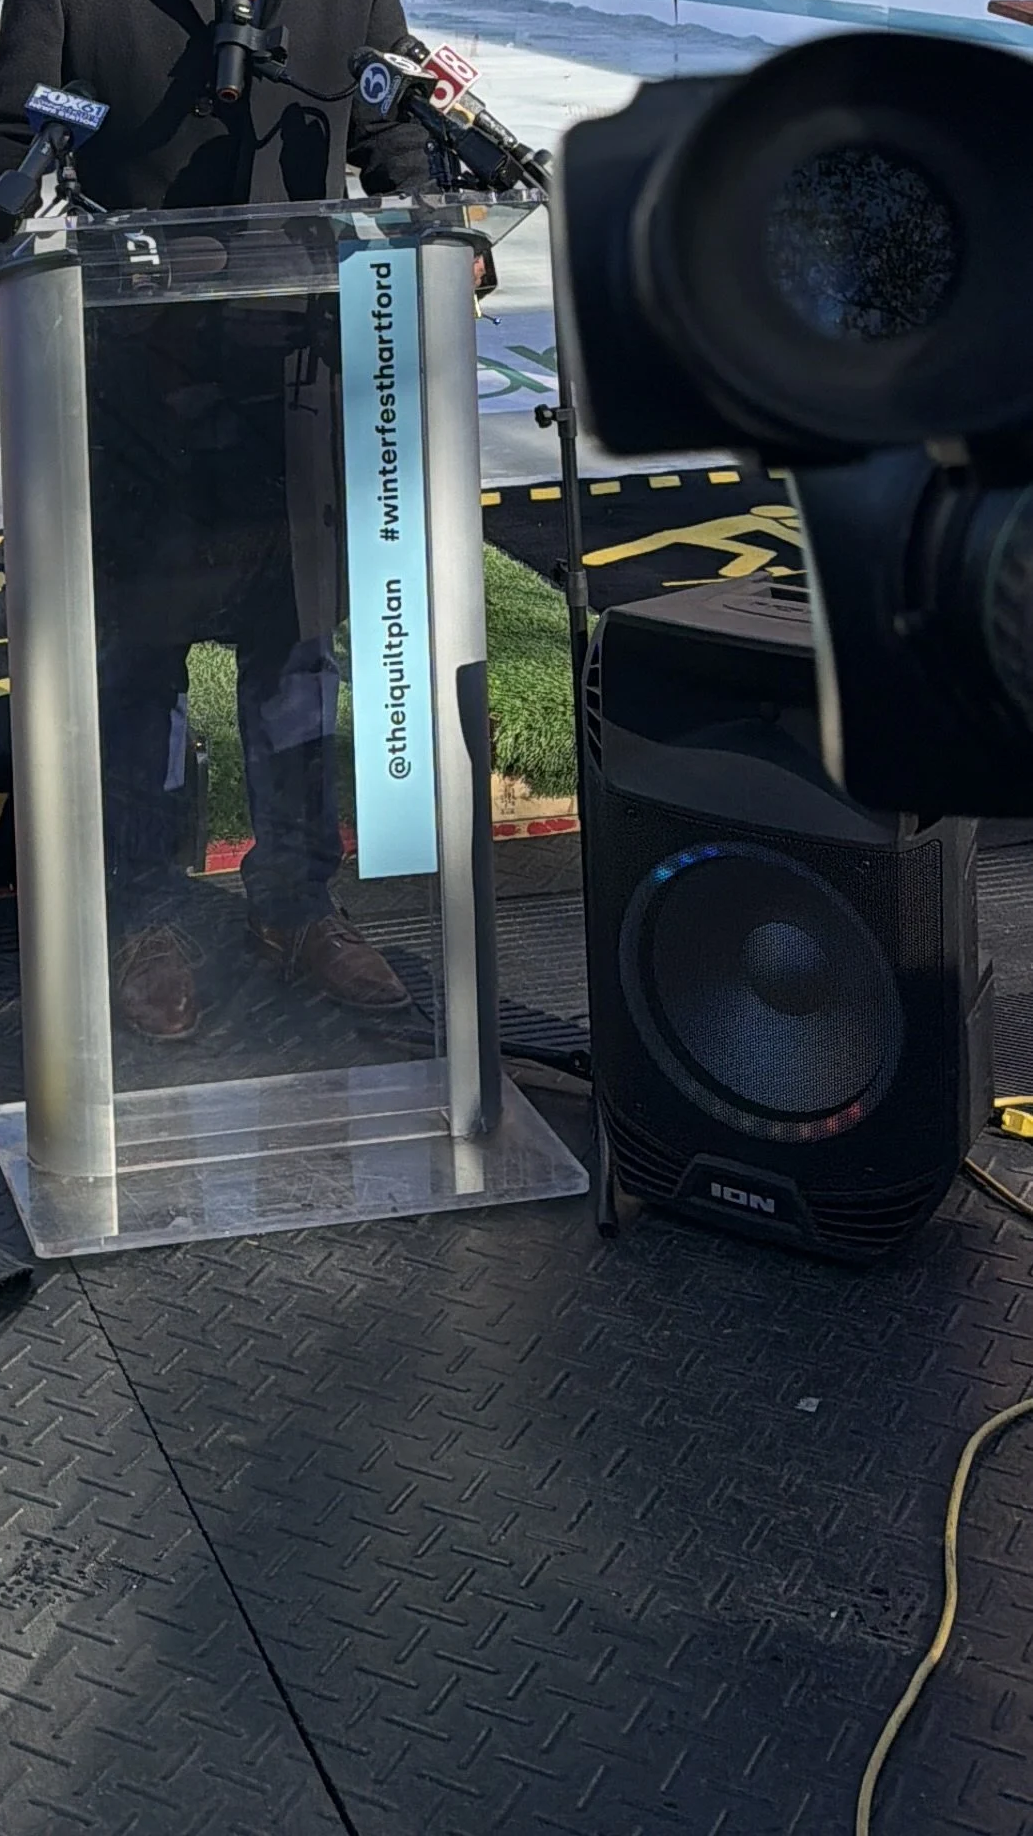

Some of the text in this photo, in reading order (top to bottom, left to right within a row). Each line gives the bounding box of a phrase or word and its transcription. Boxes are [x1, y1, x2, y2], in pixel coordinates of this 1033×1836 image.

[439, 48, 475, 80] 8
[362, 64, 388, 102] 3
[34, 85, 105, 118] FOX61
[369, 262, 412, 780] @theiquiltplan #winterfesthartford
[710, 1182, 775, 1214] ION
